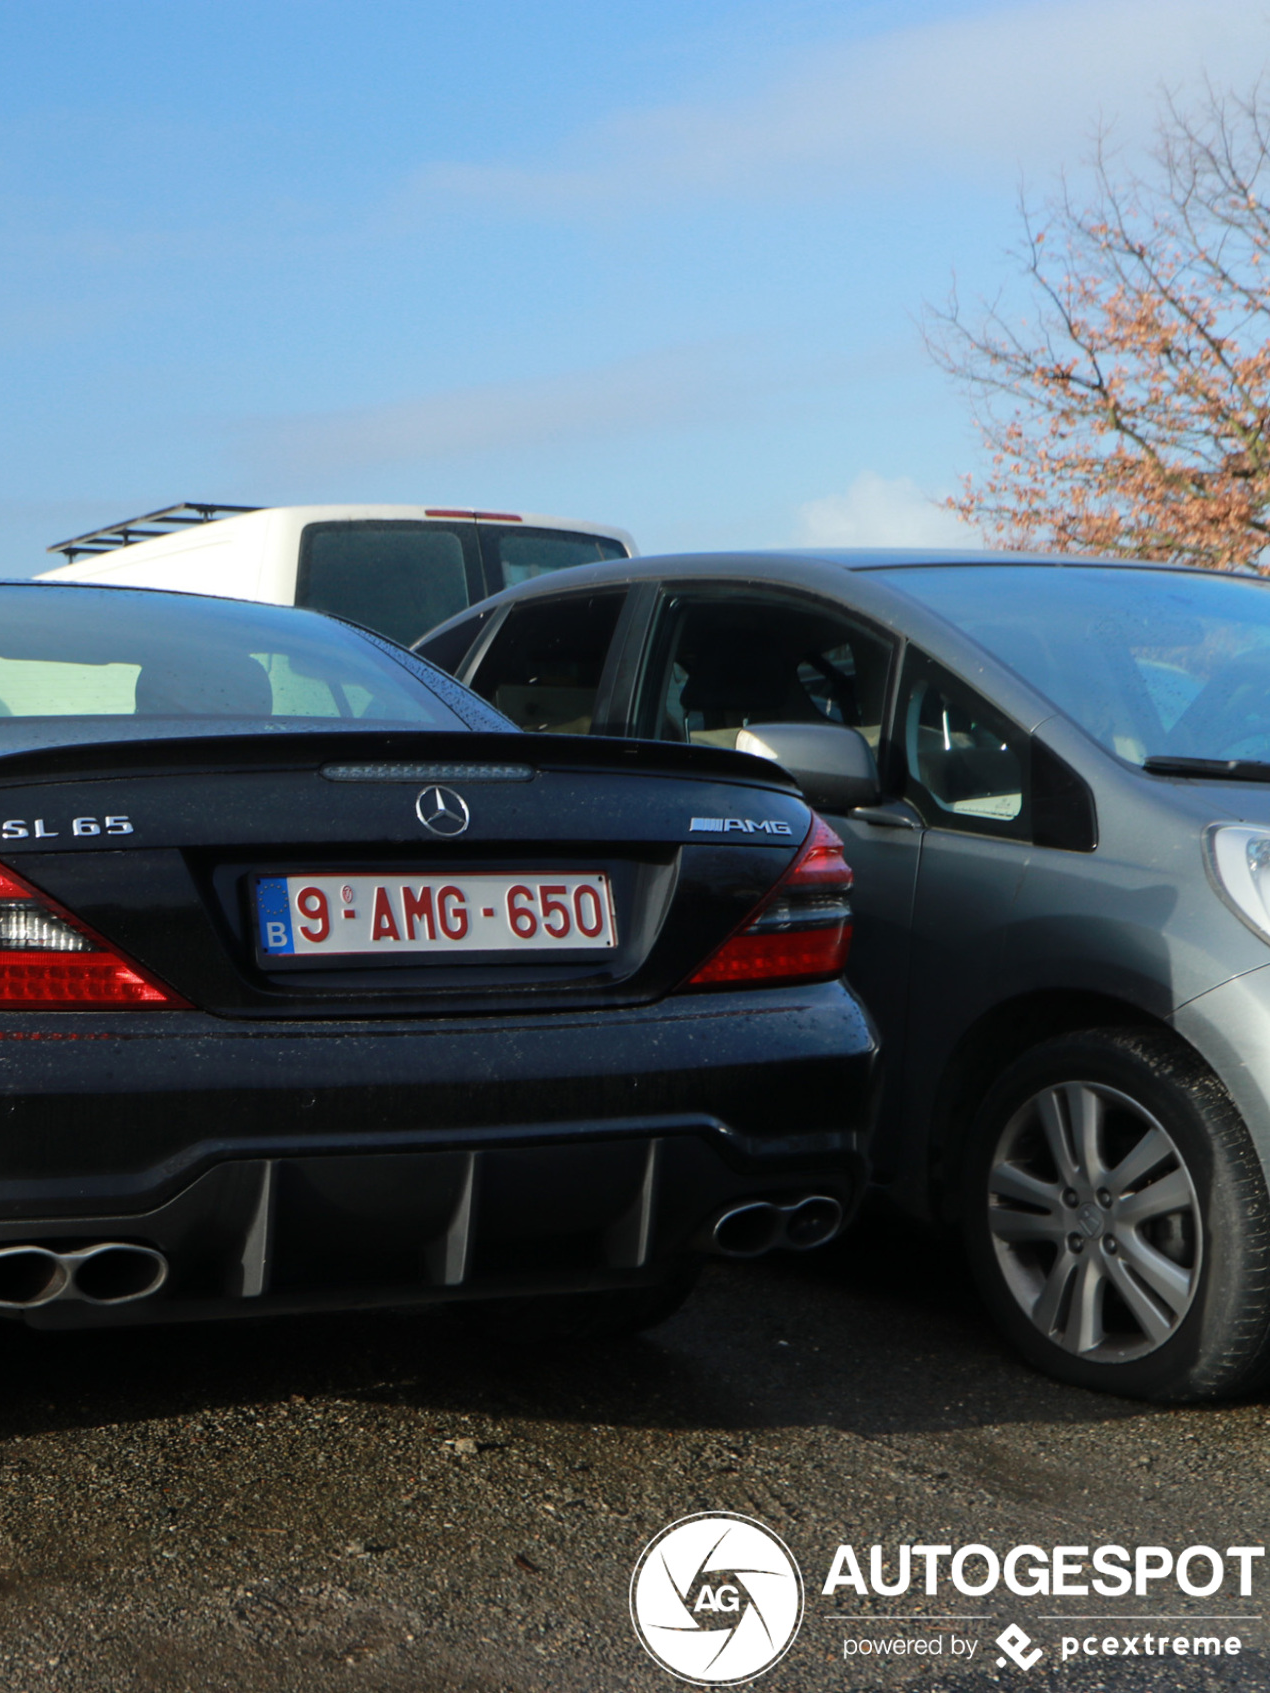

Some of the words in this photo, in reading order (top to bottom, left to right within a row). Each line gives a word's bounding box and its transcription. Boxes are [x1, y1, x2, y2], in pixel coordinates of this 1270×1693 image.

[2, 819, 59, 839] SL
[72, 815, 134, 836] 65
[724, 818, 793, 836] AMG
[266, 921, 288, 948] B
